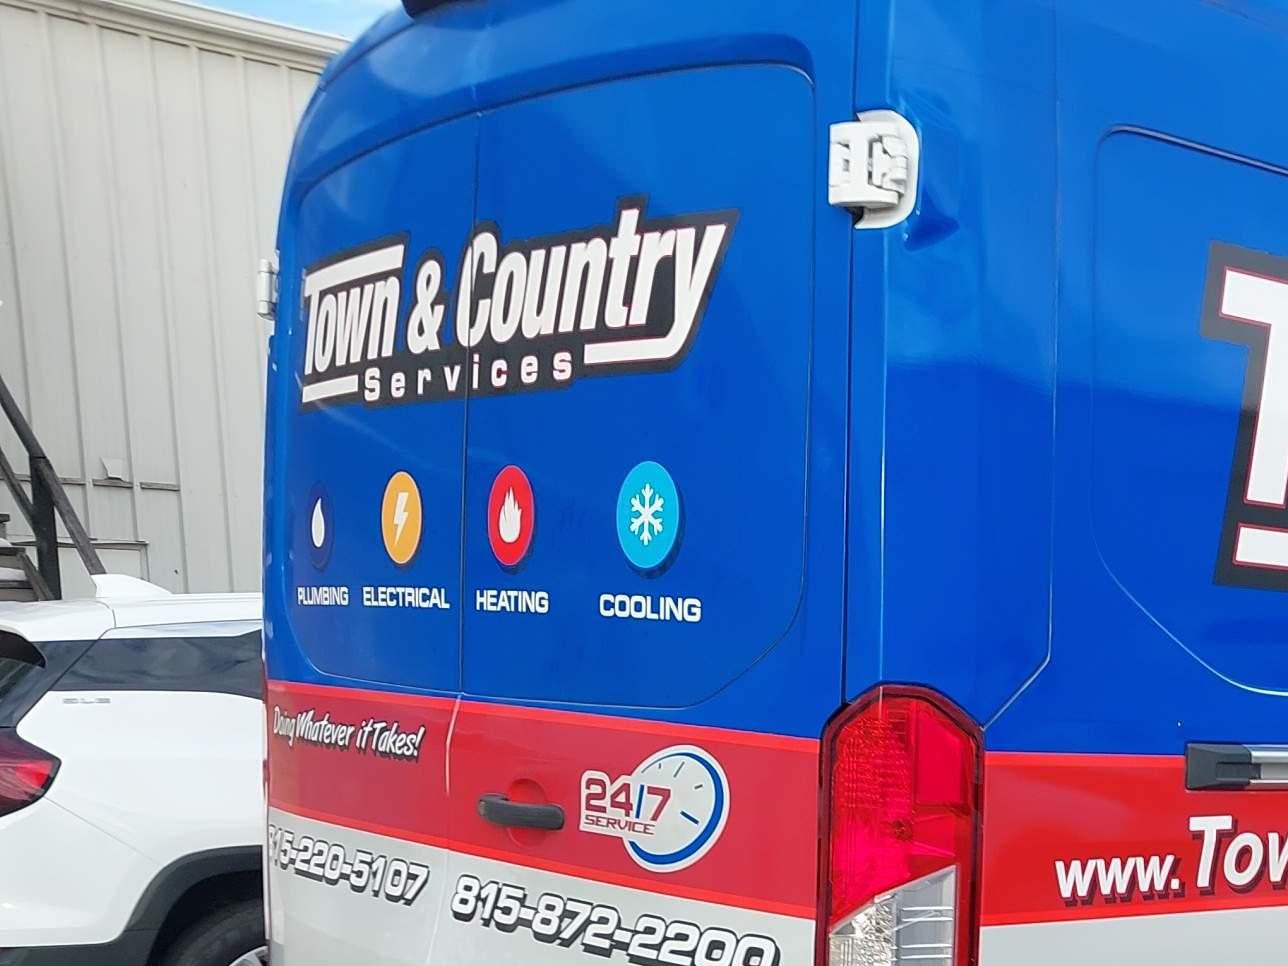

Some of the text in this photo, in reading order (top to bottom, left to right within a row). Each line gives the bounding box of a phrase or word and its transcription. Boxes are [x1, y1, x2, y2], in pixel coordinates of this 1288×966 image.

[304, 207, 726, 377] Town & Country
[363, 350, 572, 401] Services
[297, 586, 702, 622] PLUMBING ELECTRICAL HEATING COOLING
[273, 706, 425, 760] Doing Whatever it Takes!
[584, 814, 656, 835] SERVICE
